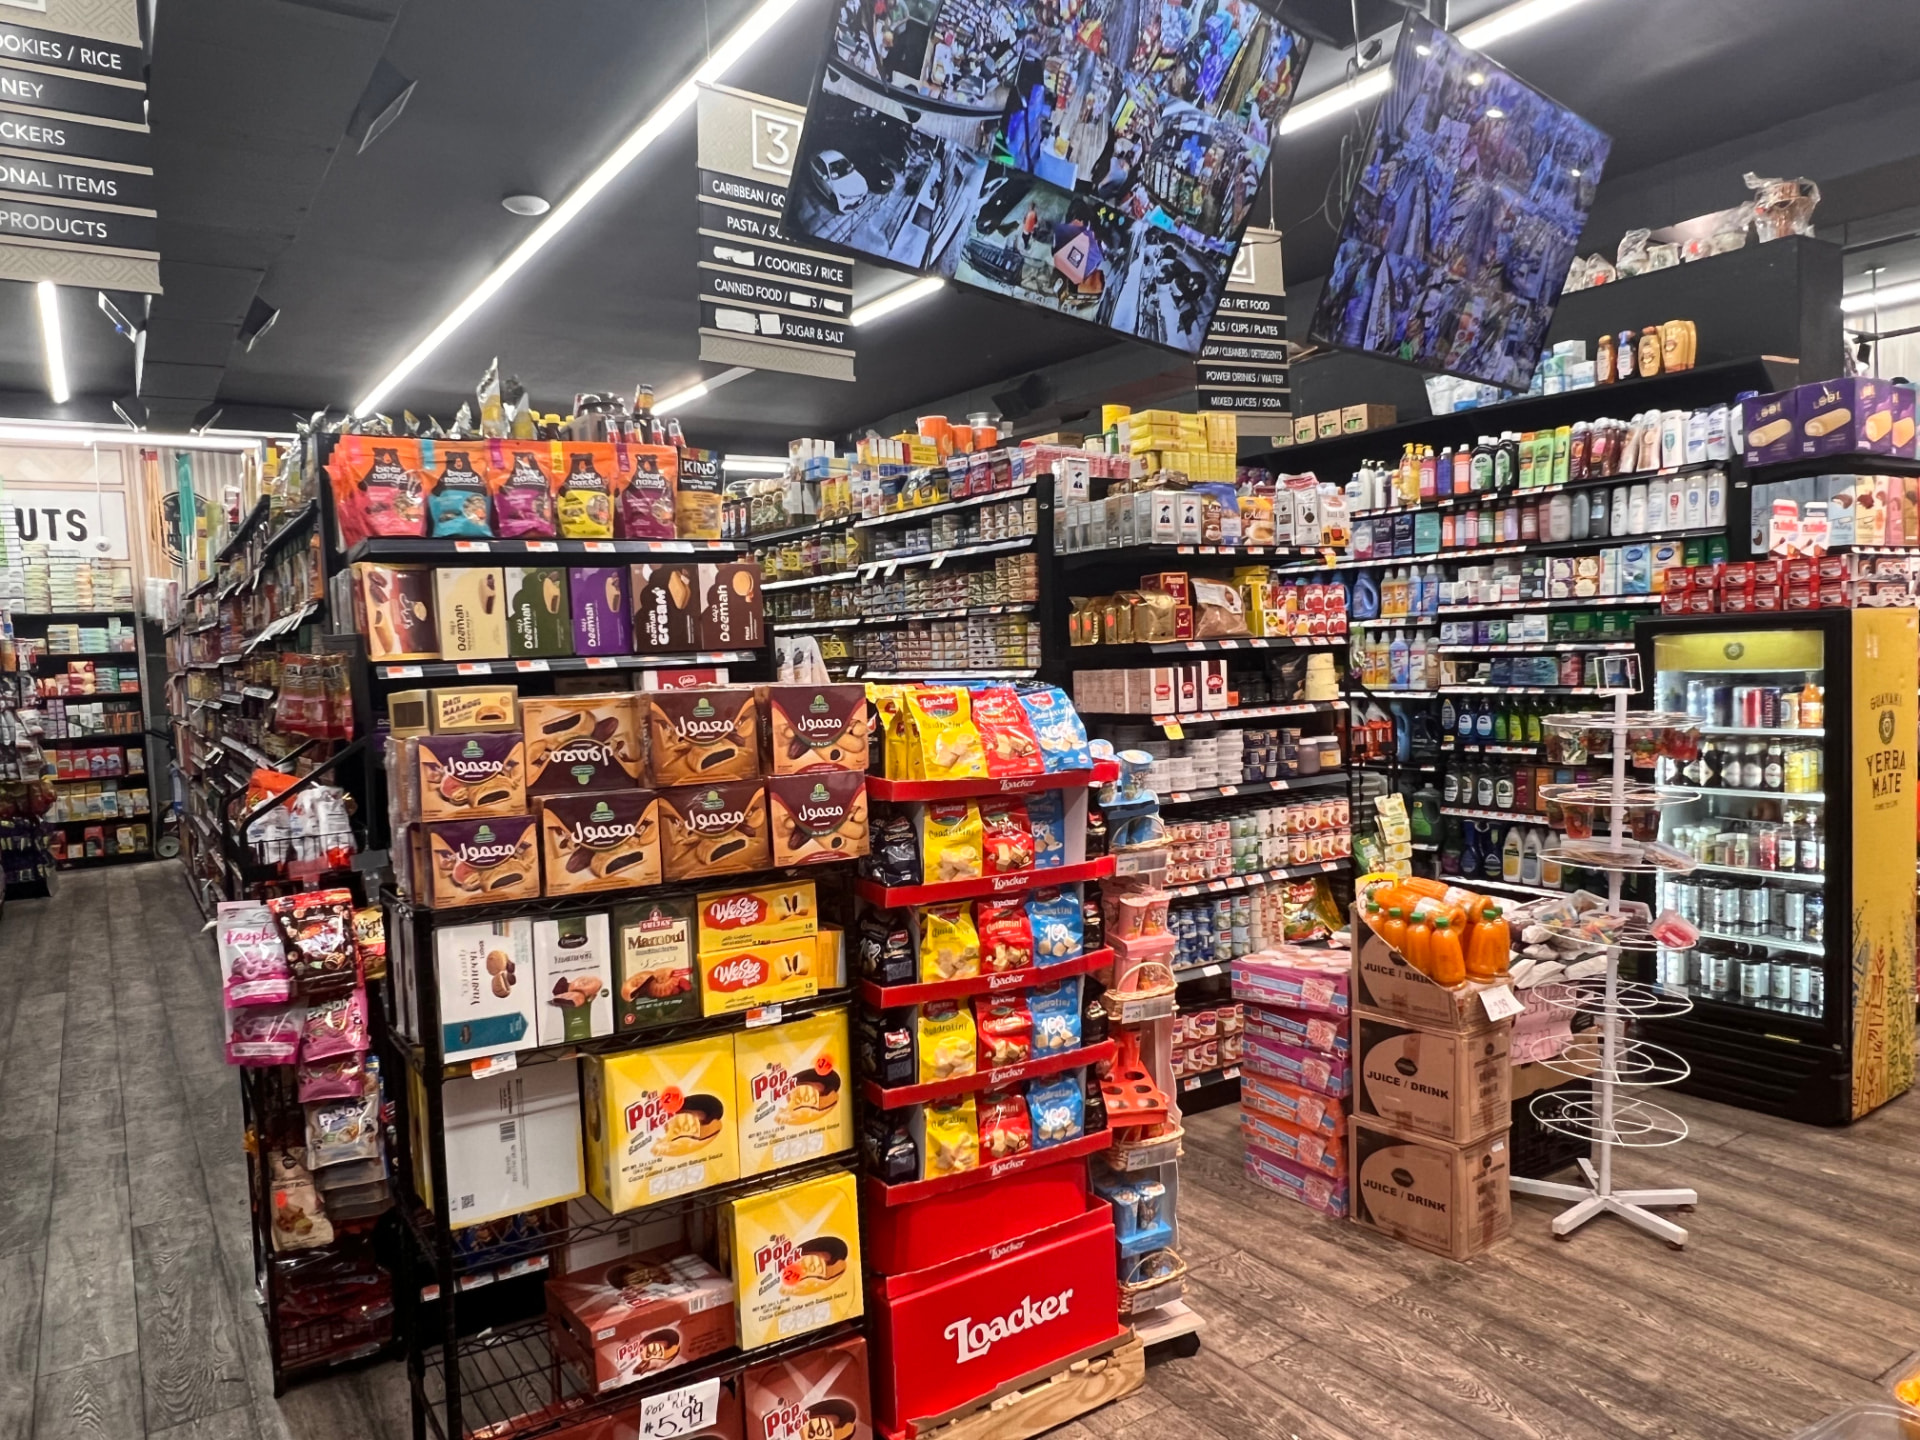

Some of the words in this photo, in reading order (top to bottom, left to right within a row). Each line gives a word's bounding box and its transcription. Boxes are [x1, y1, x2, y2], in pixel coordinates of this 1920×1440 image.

[80, 48, 122, 70] RICE
[766, 121, 790, 165] 3
[58, 174, 117, 196] ITEMS
[712, 179, 764, 204] CARIBBEAN
[0, 209, 108, 238] PRODUCTS
[727, 216, 759, 235] PASTA
[765, 255, 811, 277] COOKIES
[821, 266, 844, 282] RICE
[714, 278, 754, 298] CANNED
[755, 284, 783, 303] FOOD
[1236, 298, 1248, 310] PET
[1249, 300, 1271, 311] FOOD
[786, 322, 815, 340] SUGAR
[817, 327, 824, 341] &
[825, 328, 845, 344] SALT
[1231, 322, 1249, 334] CUPS
[1254, 324, 1279, 336] PLATES
[1222, 346, 1249, 358] CLEANERS
[1206, 370, 1232, 382] POWER
[1232, 371, 1257, 383] DRINKS
[1261, 373, 1285, 385] WATER
[1211, 395, 1234, 407] MIXED
[1234, 397, 1258, 408] JUICES
[1262, 398, 1282, 409] SODA
[447, 469, 474, 478] bear
[572, 472, 596, 482] bear
[684, 459, 717, 476] KIND
[443, 475, 479, 484] naked
[568, 478, 602, 488] naked
[717, 584, 731, 643] Deemah
[455, 603, 467, 652] Deemah
[522, 602, 534, 649] Deemah
[585, 602, 597, 648] Deemah
[649, 609, 659, 645] Deemah
[919, 696, 955, 709] Loacker
[676, 716, 735, 737] معمول
[798, 715, 843, 732] معمول
[444, 757, 505, 777] معمول
[550, 745, 614, 767] معمول
[1865, 750, 1907, 777] YERBA
[1000, 778, 1037, 792] Loacker
[1872, 772, 1903, 799] MATE
[685, 808, 745, 831] معمول
[799, 805, 844, 822] معمول
[571, 821, 637, 844] معمول
[456, 843, 516, 861] معمول
[991, 876, 1030, 891] Loacker
[710, 896, 760, 924] WeSee
[714, 958, 762, 986] WeSee
[1364, 961, 1396, 978] JUICE
[987, 974, 1025, 989] Loacker
[988, 1067, 1026, 1084] Loacker
[1367, 1070, 1401, 1088] JUICE
[1410, 1081, 1450, 1100] DRINK
[773, 1077, 797, 1102] kek
[317, 1102, 367, 1128] PANDA
[989, 1158, 1027, 1177] Loacker
[1363, 1179, 1397, 1198] JUICE
[1407, 1191, 1447, 1214] DRINK
[989, 1240, 1026, 1260] Loacker
[943, 1287, 1074, 1365] Loacker
